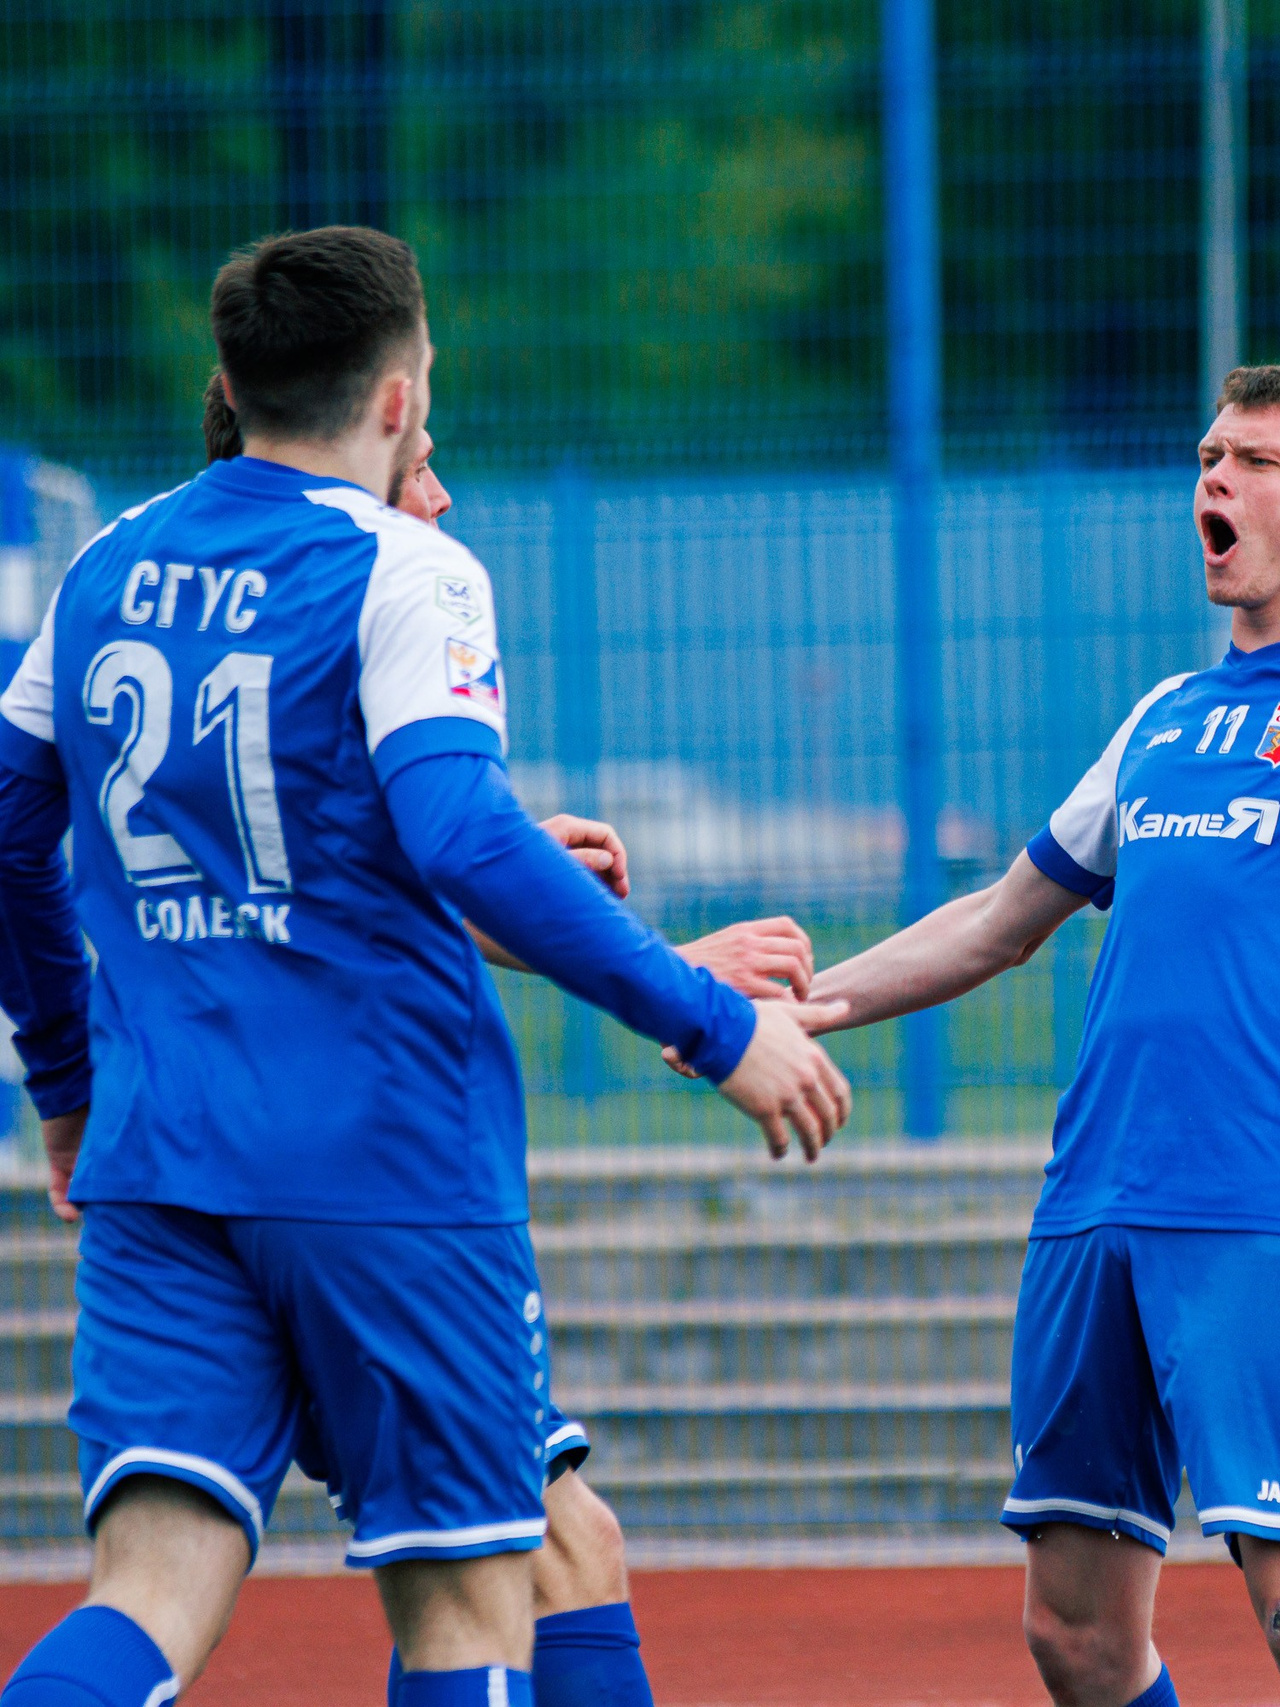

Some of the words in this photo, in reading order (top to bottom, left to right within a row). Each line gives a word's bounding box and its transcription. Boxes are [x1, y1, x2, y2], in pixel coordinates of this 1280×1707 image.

[120, 560, 267, 633] СГУС
[1195, 705, 1250, 754] 11
[82, 639, 294, 894] 21
